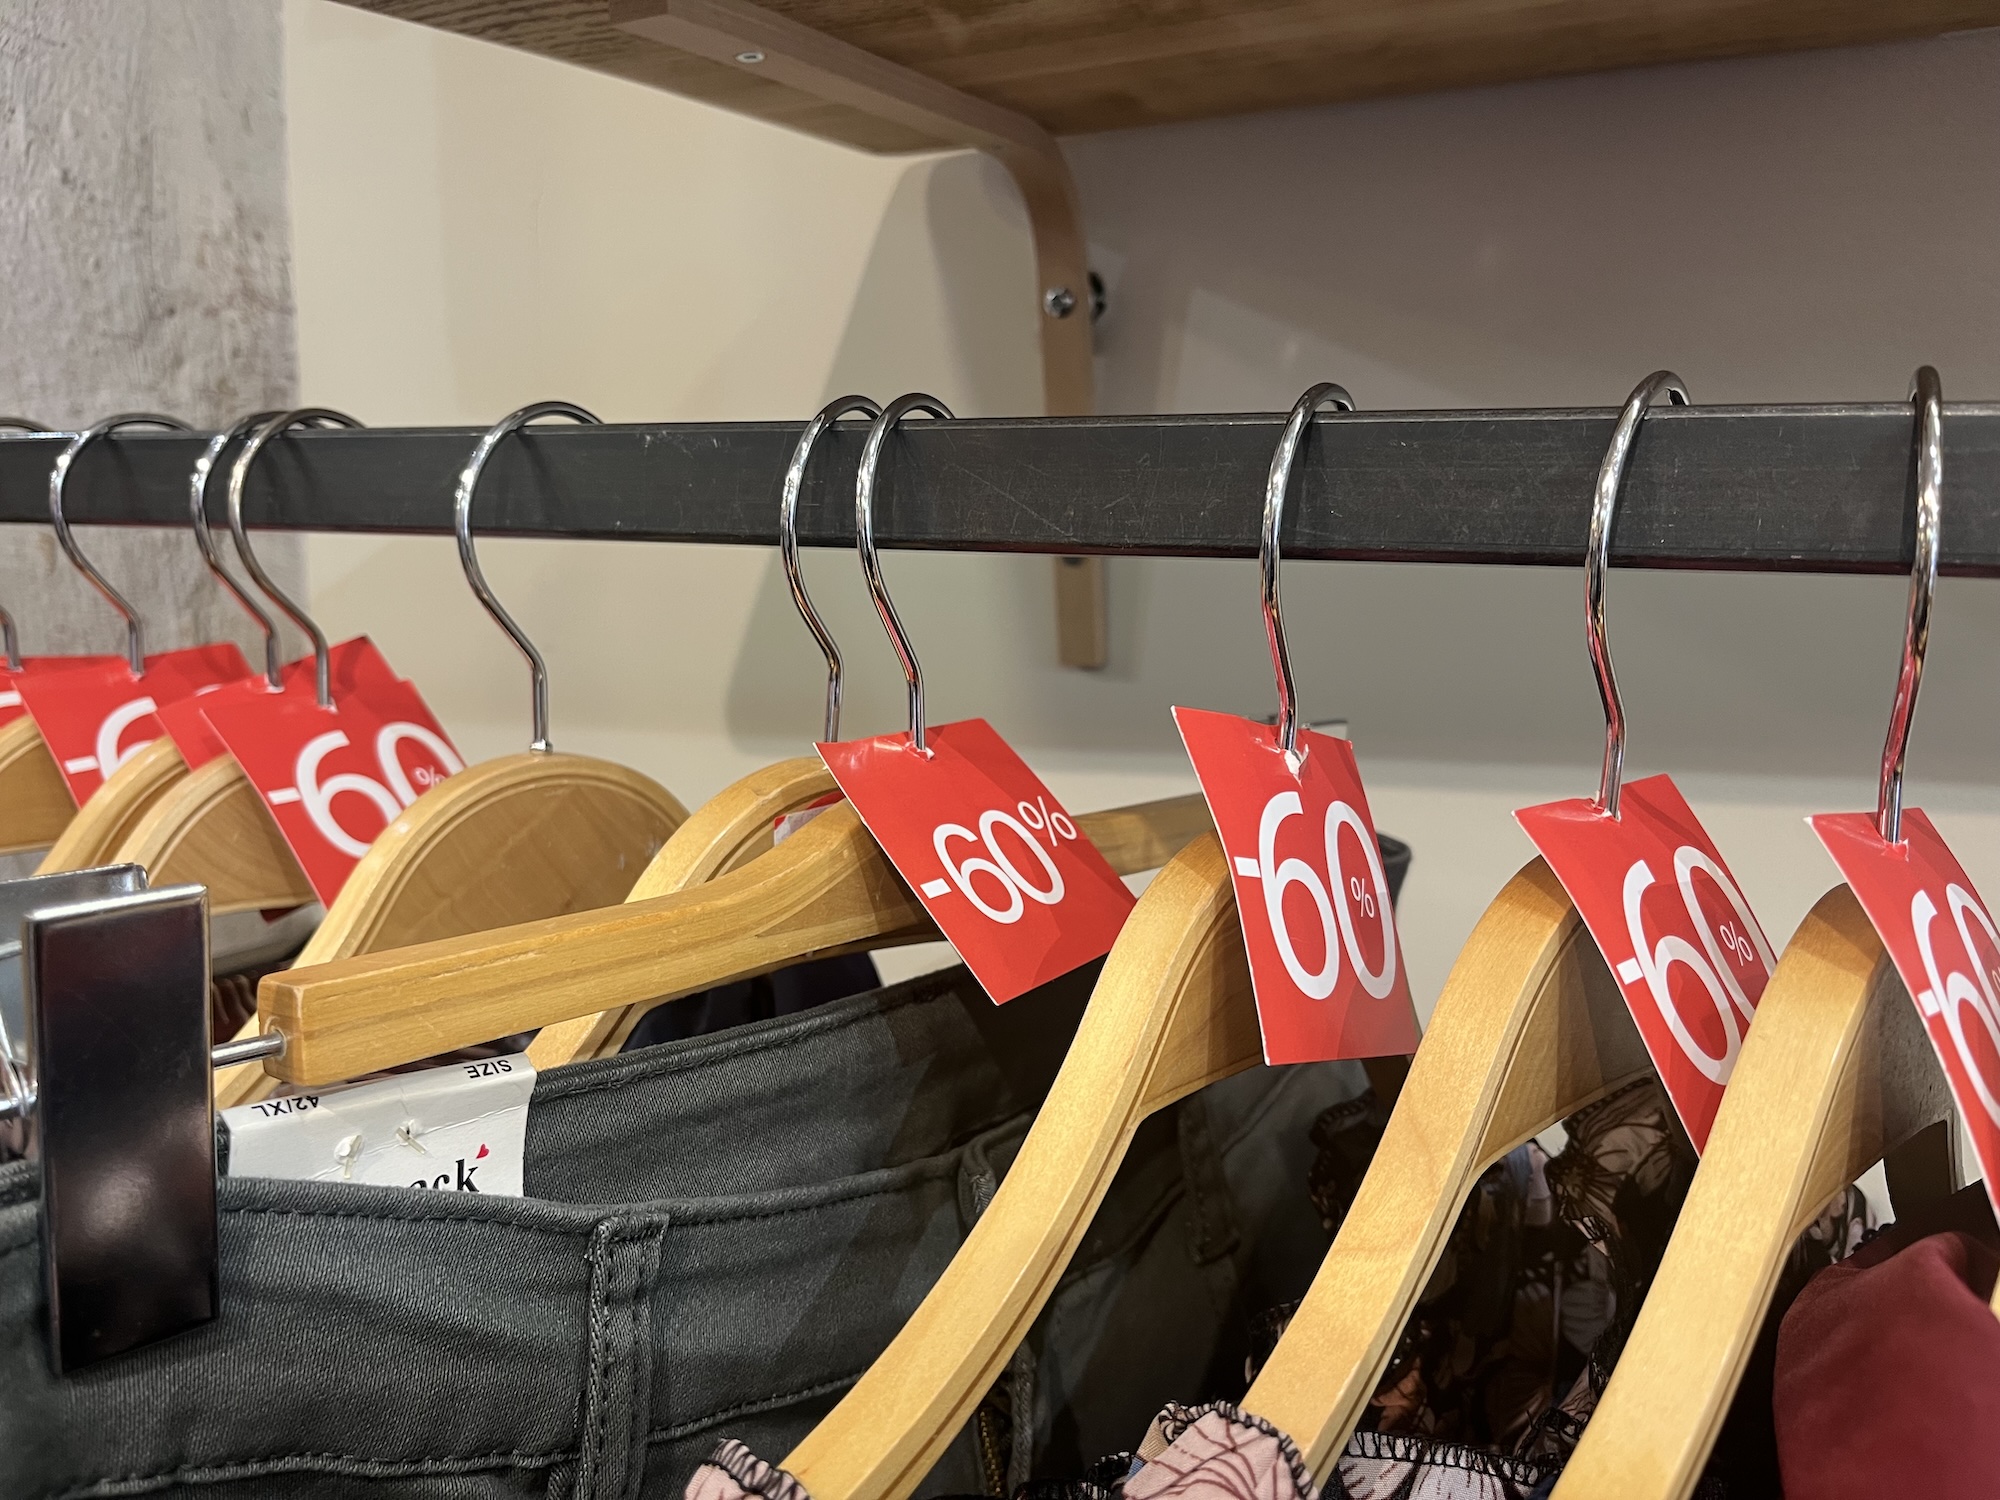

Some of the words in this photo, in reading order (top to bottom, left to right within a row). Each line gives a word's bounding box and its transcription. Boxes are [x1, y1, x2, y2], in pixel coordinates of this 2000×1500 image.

[919, 796, 1077, 924] -60%
[463, 1059, 513, 1079] SIZE
[250, 1095, 319, 1117] 42/XL
